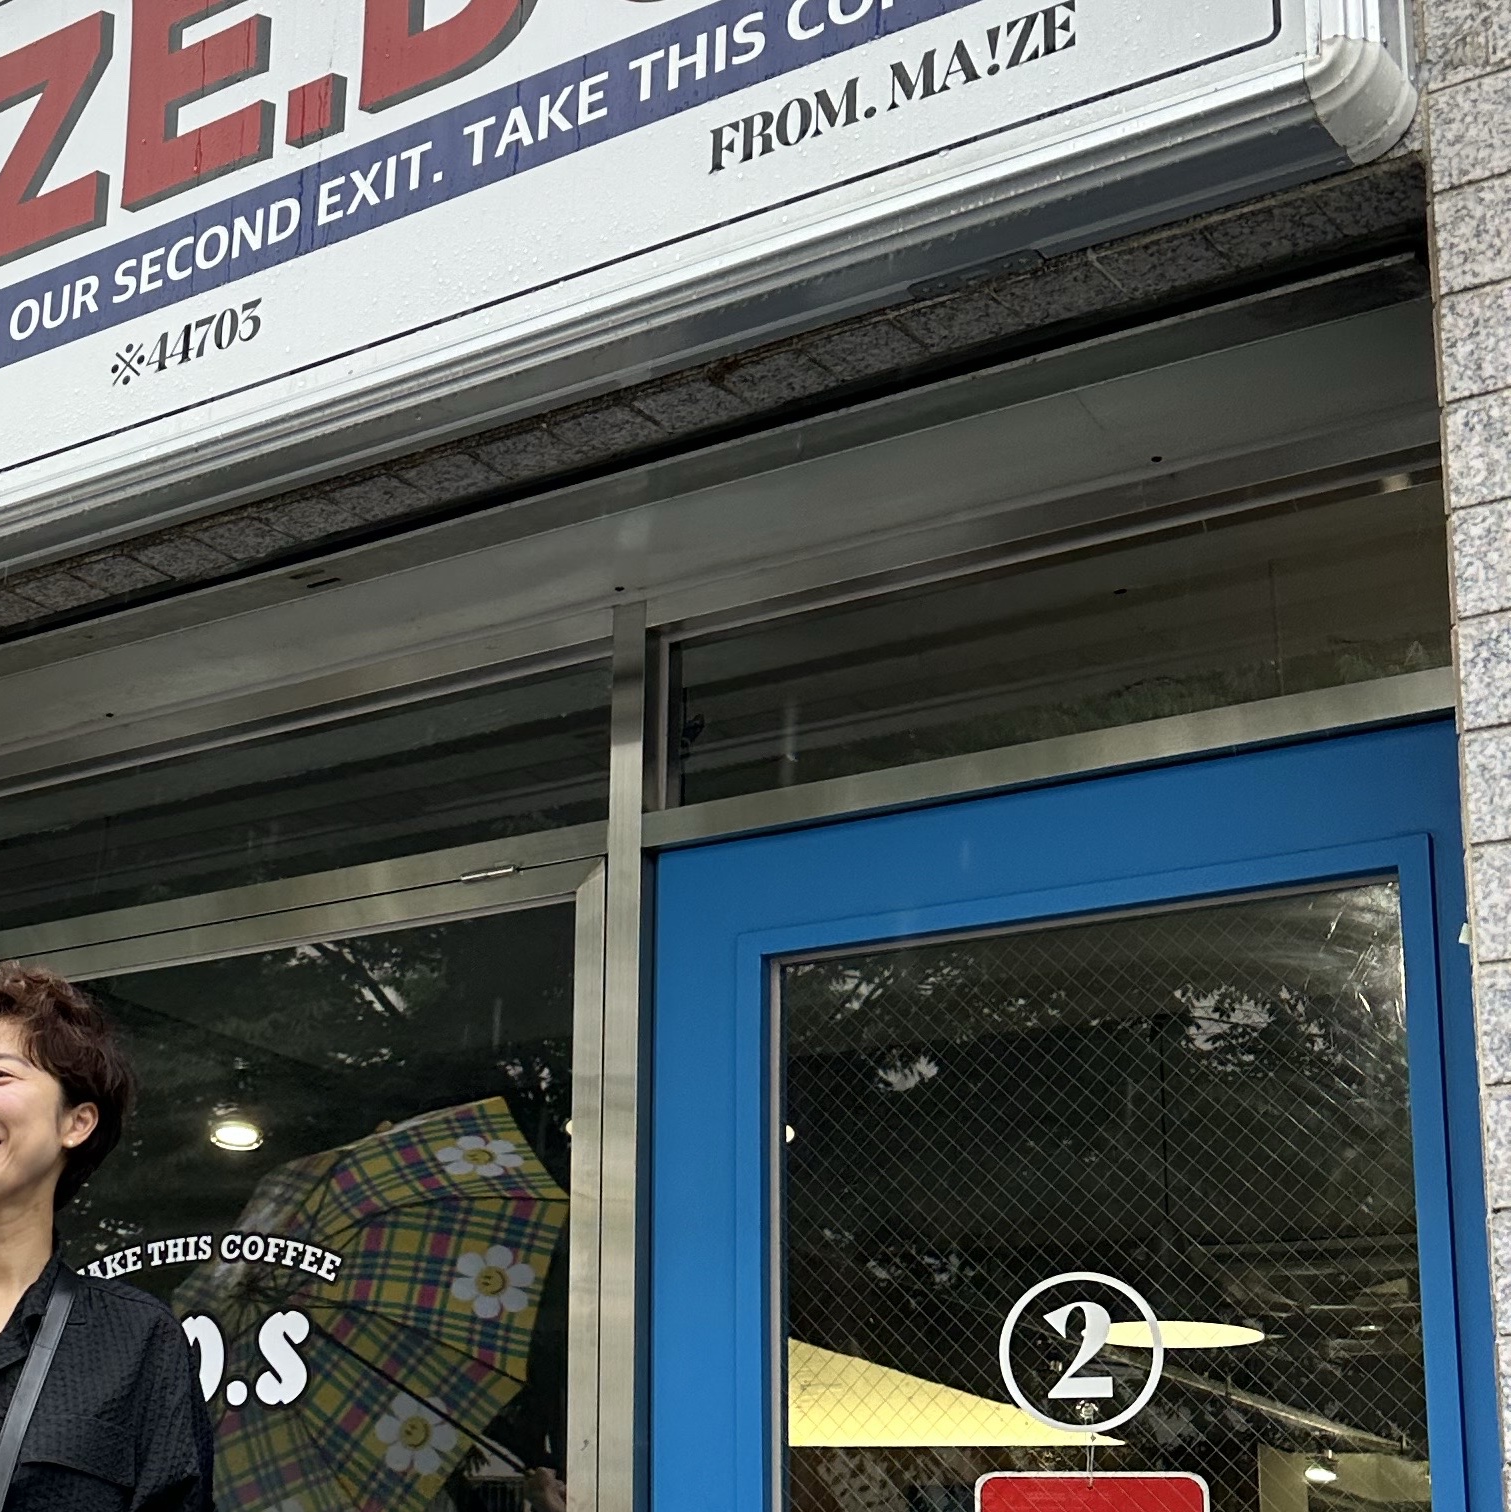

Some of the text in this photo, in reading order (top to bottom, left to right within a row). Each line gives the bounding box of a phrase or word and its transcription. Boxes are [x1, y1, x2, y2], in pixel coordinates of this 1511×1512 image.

[708, 1, 1078, 175] FROM. MA!ZE
[8, 274, 99, 340] OUR
[112, 197, 303, 304] SECOND
[317, 141, 444, 227] EXIT.
[462, 70, 609, 167] TAKE
[629, 11, 767, 103] THIS
[147, 1235, 212, 1267] THIS
[220, 1234, 343, 1283] COFFEE
